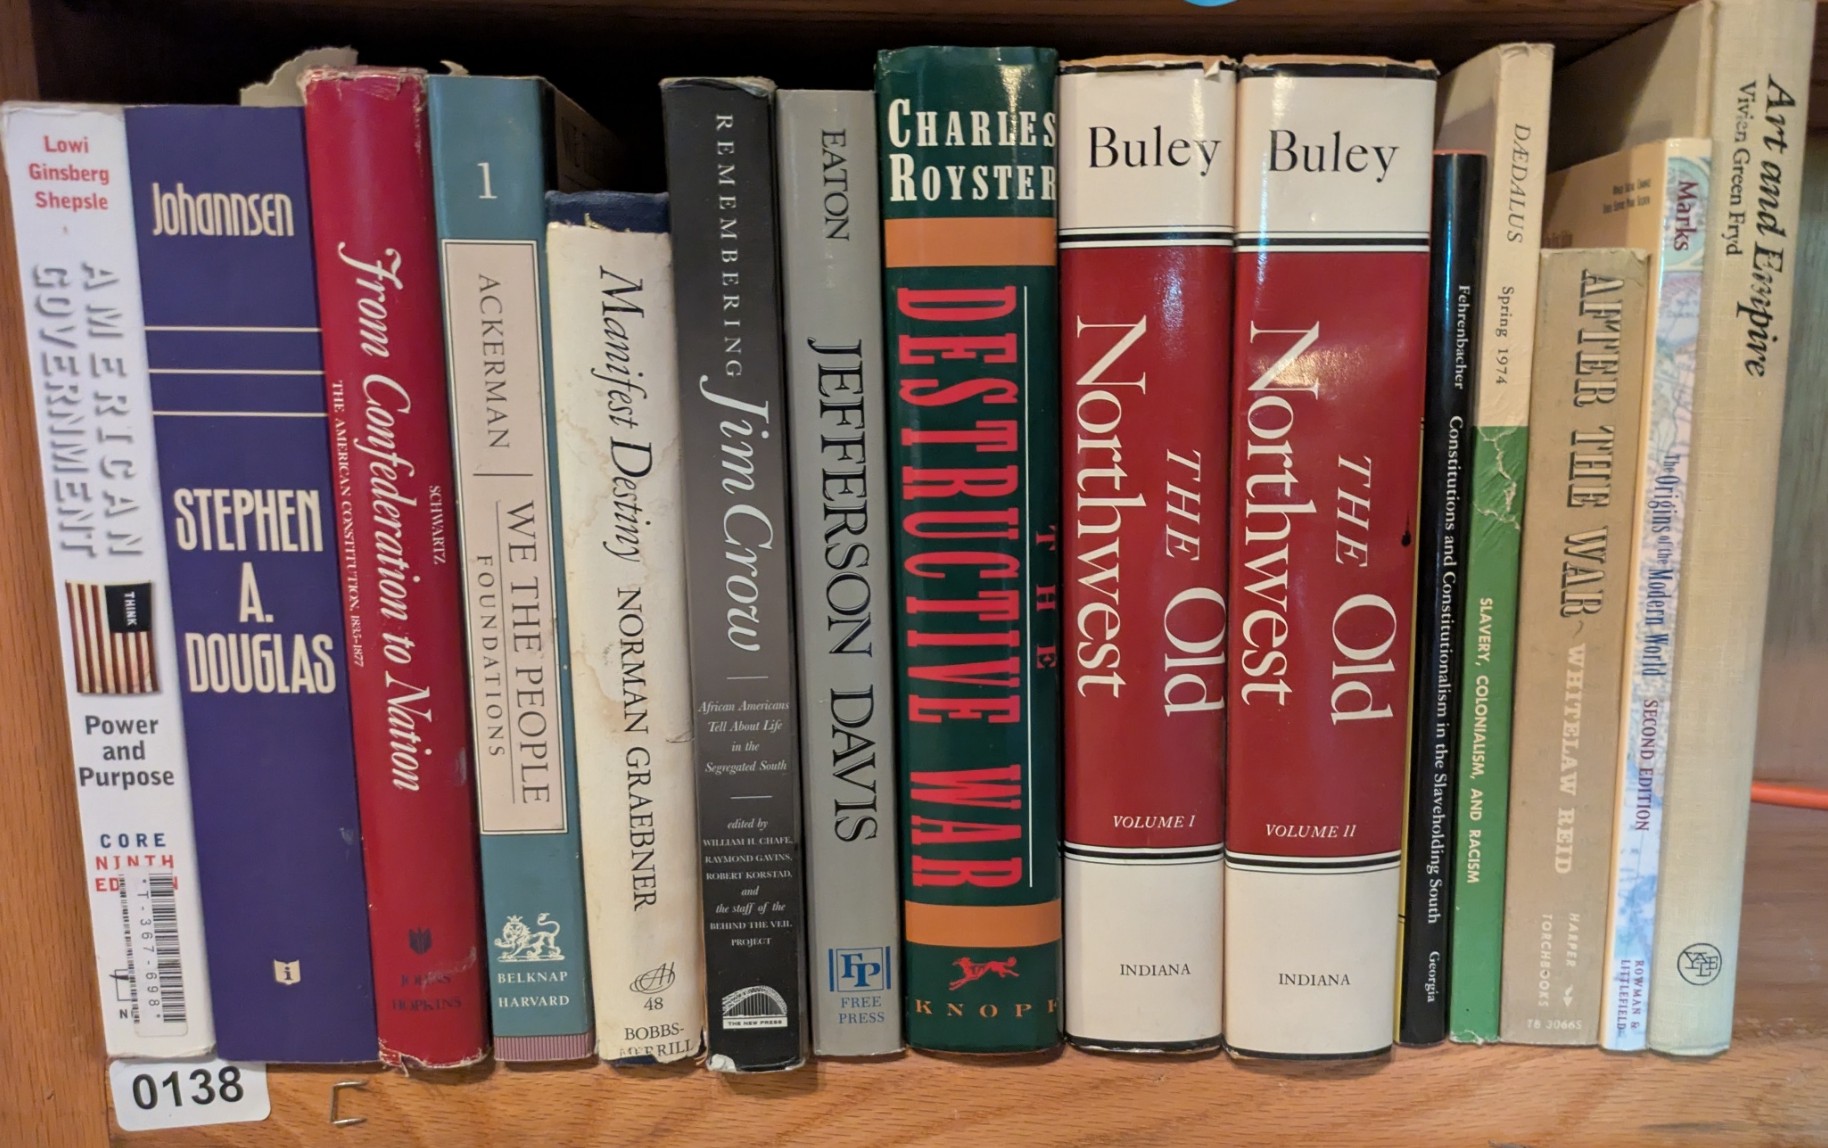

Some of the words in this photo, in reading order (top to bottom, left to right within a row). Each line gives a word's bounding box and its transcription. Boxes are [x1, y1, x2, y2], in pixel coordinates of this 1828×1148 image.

[888, 98, 1056, 148] CHARLES
[1762, 74, 1796, 155] Art
[28, 163, 110, 185] Ginsberg
[43, 136, 89, 154] Lowi
[1088, 125, 1222, 177] Buley
[1269, 129, 1400, 183] Buley
[35, 190, 109, 212] Shepsle
[476, 161, 497, 200] 1
[821, 128, 851, 242] EATON
[889, 153, 1056, 202] ROYSTER
[1728, 147, 1751, 206] Green
[1757, 160, 1788, 239] and
[152, 182, 295, 236] Johannsen
[1673, 180, 1700, 252] Marks
[1721, 210, 1747, 257] Fryd
[716, 114, 743, 378] REMEMBERING
[338, 242, 403, 357] From
[1495, 285, 1515, 338] Spring
[1736, 240, 1785, 379] Empire
[478, 273, 510, 449] ACKERMAN
[591, 265, 648, 430] Manifest
[1454, 284, 1471, 390] Fehrenbacher
[1573, 268, 1625, 408] AFTER
[1495, 348, 1509, 385] 1974
[32, 264, 98, 556] GOVERNMENT
[81, 261, 143, 556] AMERICAN
[331, 379, 345, 413] THE
[333, 418, 353, 497] AMERICAN
[699, 374, 770, 495] Jim
[1663, 453, 1681, 473] The
[1444, 415, 1464, 531] Constitutions
[1566, 425, 1616, 508] THE
[174, 488, 324, 552] STEPHEN
[353, 373, 420, 622] Confederation
[428, 485, 446, 565] SCHWARTZ
[602, 436, 653, 563] Destiny
[807, 336, 874, 658] JEFFERSON
[897, 285, 1022, 724] DESTRUCTIVE
[1076, 314, 1148, 698] Northwest
[1166, 449, 1202, 562] THE
[1240, 320, 1321, 707] Northwest
[1335, 455, 1372, 567] THE
[1647, 475, 1681, 534] Origins
[506, 500, 538, 563] WE
[1443, 534, 1458, 567] and
[1656, 549, 1673, 566] the
[239, 562, 275, 622] A.
[723, 503, 774, 652] Crow
[1036, 524, 1058, 670] THE
[1559, 525, 1609, 619] WAR
[1644, 568, 1674, 626] Modern
[122, 591, 137, 626] THINK
[510, 576, 543, 654] THE
[1474, 597, 1493, 666] SLAVERY,
[185, 632, 337, 694] DOUGLAS
[382, 632, 415, 665] to
[476, 555, 506, 757] FOUNDATIONS
[616, 587, 650, 735] NORMAN
[1163, 586, 1227, 717] Old
[1331, 593, 1398, 726] Old
[1436, 571, 1457, 718] Constitutionalism
[1641, 633, 1670, 677] World
[84, 715, 159, 735] Power
[385, 672, 432, 793] Nation
[515, 665, 551, 805] PEOPLE
[697, 701, 735, 715] African
[738, 700, 790, 711] Americans
[708, 721, 728, 732] Tell
[730, 720, 760, 732] About
[763, 719, 783, 733] Life
[1436, 723, 1450, 739] in
[1469, 675, 1489, 779] COLONIALISM,
[1558, 642, 1587, 797] WHITELAW
[1640, 699, 1659, 761] SECOND
[102, 740, 146, 761] and
[705, 761, 757, 775] Segregated
[759, 760, 788, 771] South
[731, 741, 742, 752] in
[745, 740, 760, 752] the
[830, 684, 879, 843] DAVIS
[1434, 742, 1449, 768] the
[78, 767, 175, 790] Purpose
[1469, 788, 1484, 822] AND
[1634, 767, 1654, 832] EDITION
[99, 833, 166, 848] CORE
[625, 746, 658, 913] GRAEBNER
[703, 838, 746, 847] WILLIAM
[727, 818, 755, 829] edited
[757, 818, 769, 831] by
[910, 764, 1023, 888] WAR
[1112, 816, 1185, 828] VOLUME
[1189, 814, 1196, 828] I
[1265, 824, 1338, 838] VOLUME
[1342, 824, 1357, 838] II
[1426, 773, 1448, 875] Slaveholding
[1554, 807, 1576, 875] REID
[705, 854, 753, 864] RAYMOND
[706, 872, 743, 880] ROBERT
[1466, 829, 1482, 885] RACISM
[715, 903, 730, 914] the
[732, 902, 755, 916] staff
[757, 902, 770, 915] of
[772, 901, 787, 911] the
[741, 885, 760, 896] and
[1427, 879, 1443, 924] South
[710, 922, 747, 930] BEHIND
[748, 920, 769, 929] THE
[731, 937, 772, 948] PROJECT
[1565, 912, 1581, 969] HARPER
[497, 971, 569, 984] BELKNAP
[1120, 963, 1191, 977] INDIANA
[1278, 973, 1351, 986] INDIANA
[1426, 950, 1442, 1003] Georgia
[1537, 913, 1553, 1008] TORCHBOOKS
[1632, 960, 1645, 1015] ROWMAN
[498, 995, 570, 1008] HARVARD
[643, 996, 664, 1011] 48
[838, 1011, 886, 1025] PRESS
[841, 996, 883, 1009] FREE
[1616, 959, 1631, 1031] LITTLEFIELD
[624, 1022, 685, 1041] BOBBS-
[131, 1065, 244, 1111] 0138
